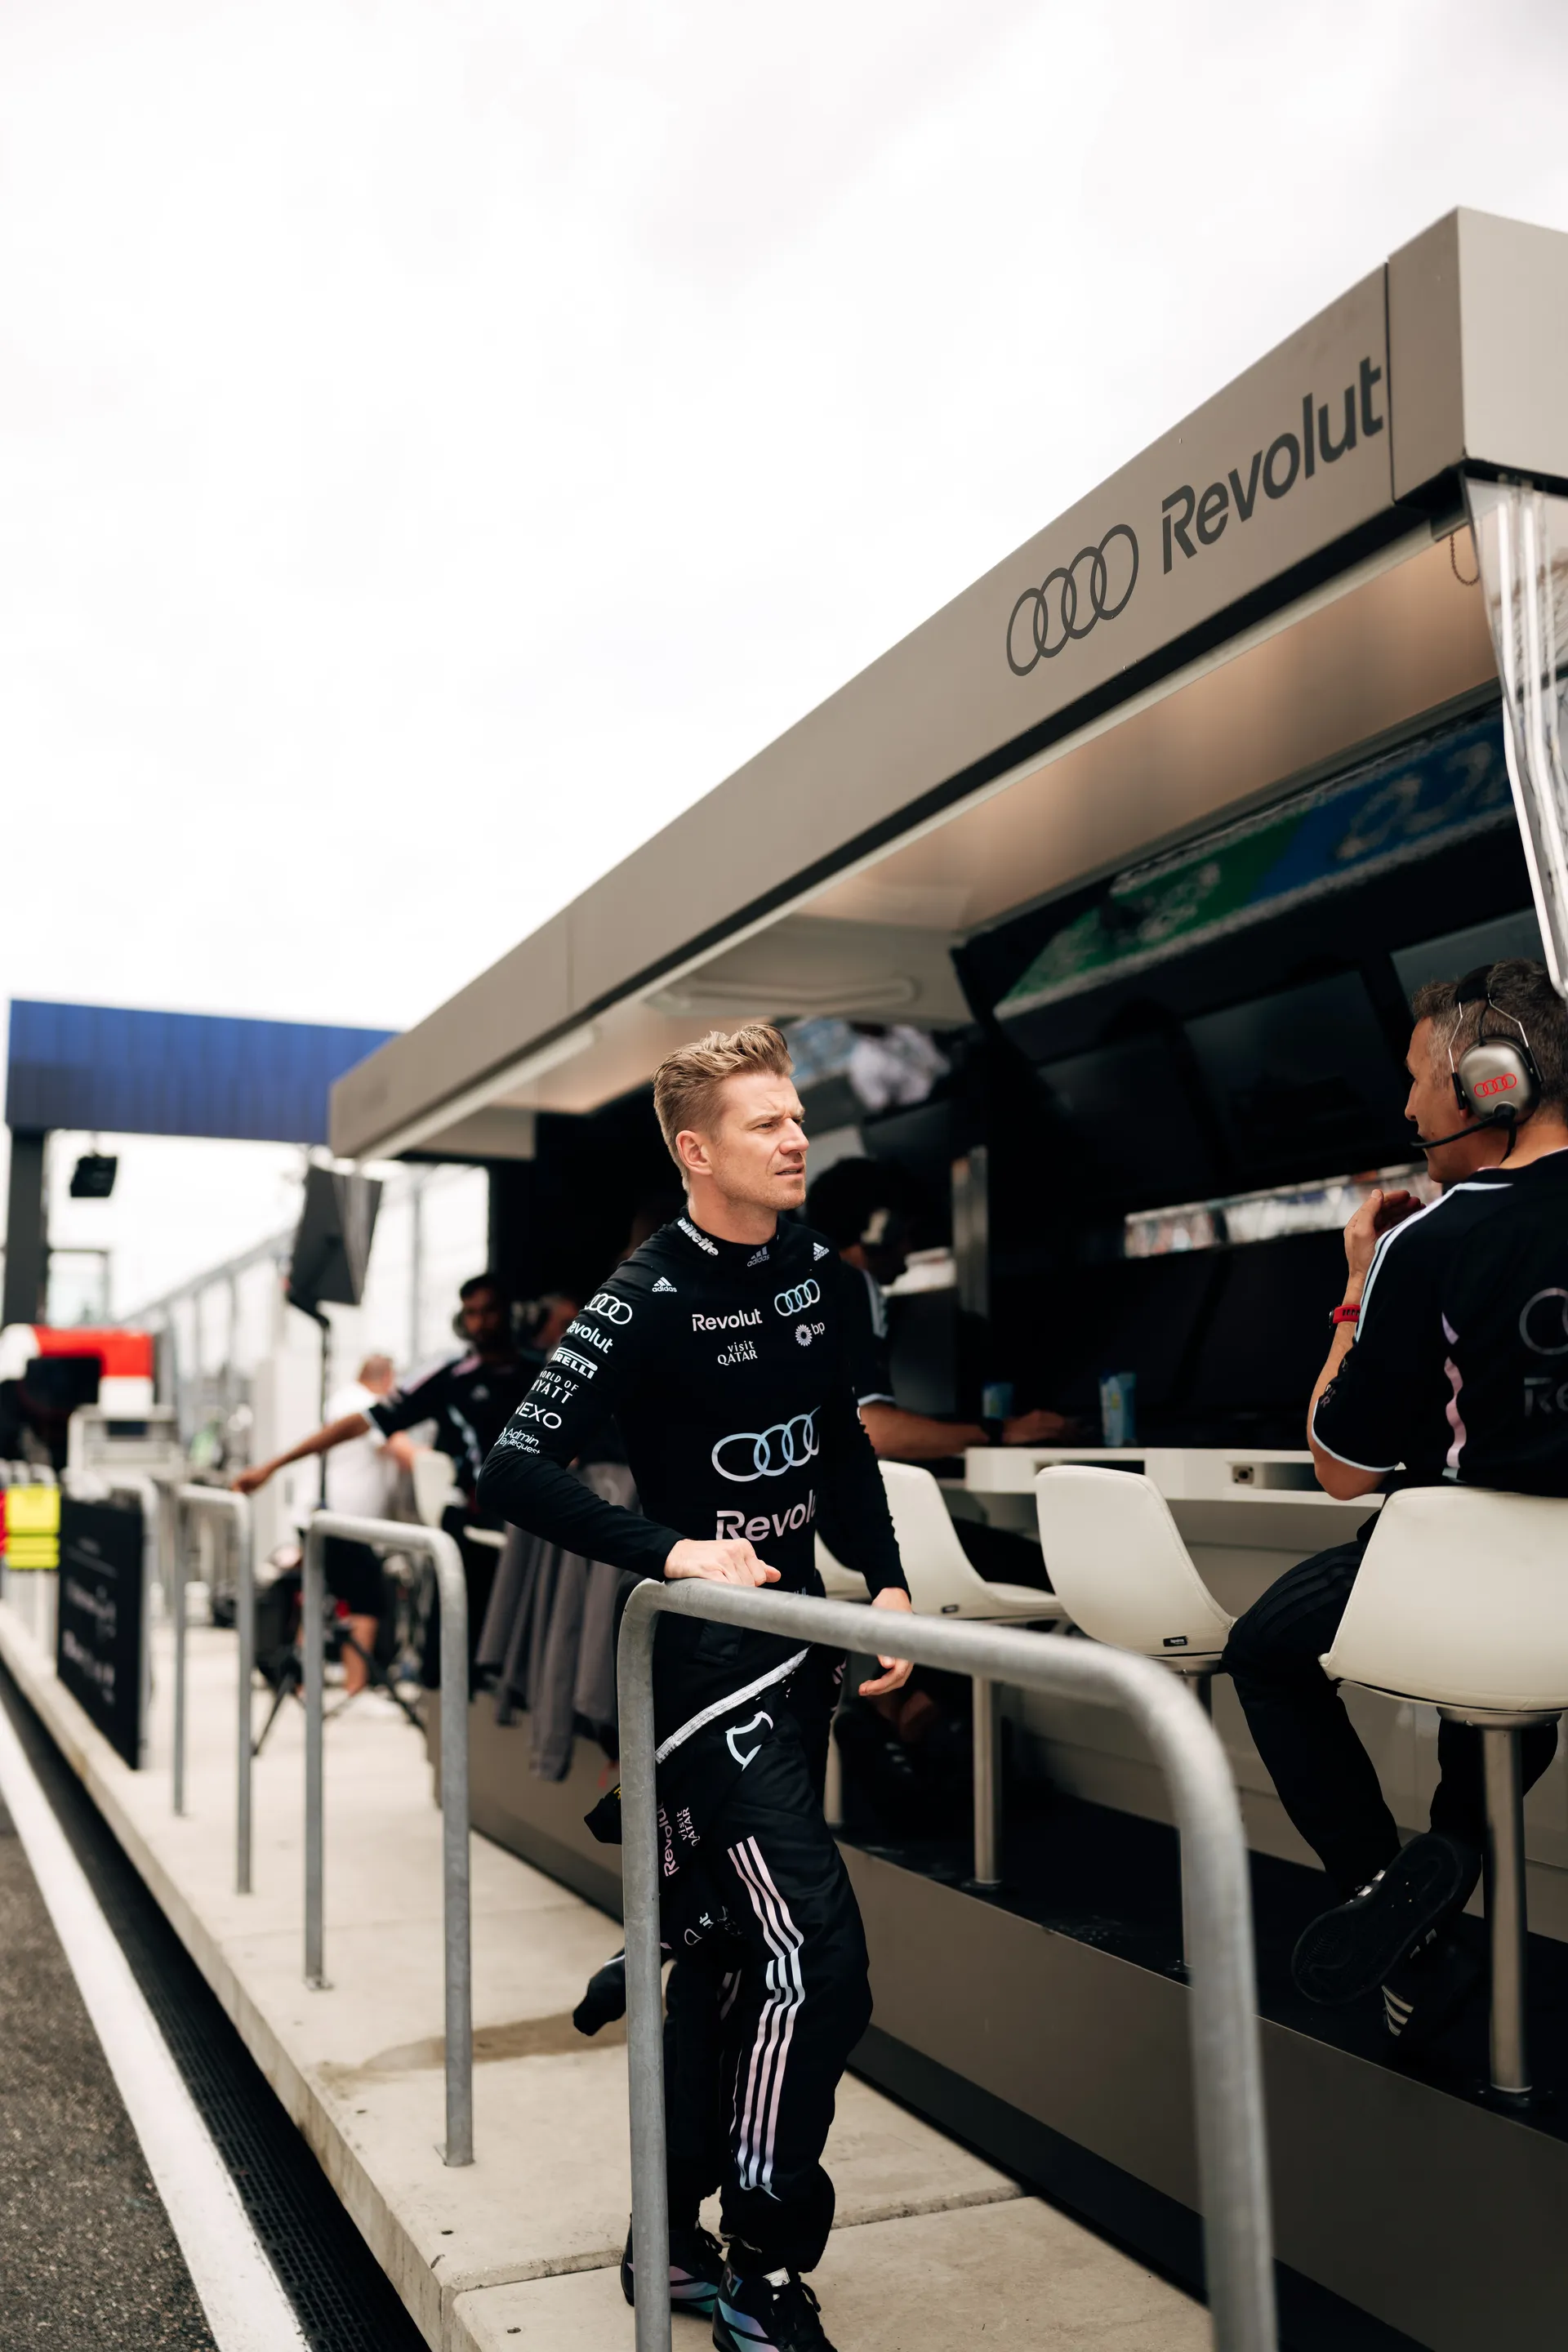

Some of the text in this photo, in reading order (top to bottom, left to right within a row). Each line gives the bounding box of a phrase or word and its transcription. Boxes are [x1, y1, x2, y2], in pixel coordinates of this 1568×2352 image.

[1162, 356, 1383, 575] Revolut
[746, 1254, 770, 1267] adidas
[813, 1247, 830, 1261] adidas
[692, 1308, 763, 1332] Revolut
[811, 1322, 826, 1335] bp
[728, 1340, 755, 1353] visit
[717, 1349, 758, 1366] QATAR
[564, 1380, 579, 1392] OF
[500, 1437, 510, 1447] By
[504, 1428, 539, 1447] Admin
[676, 1810, 688, 1841] visit
